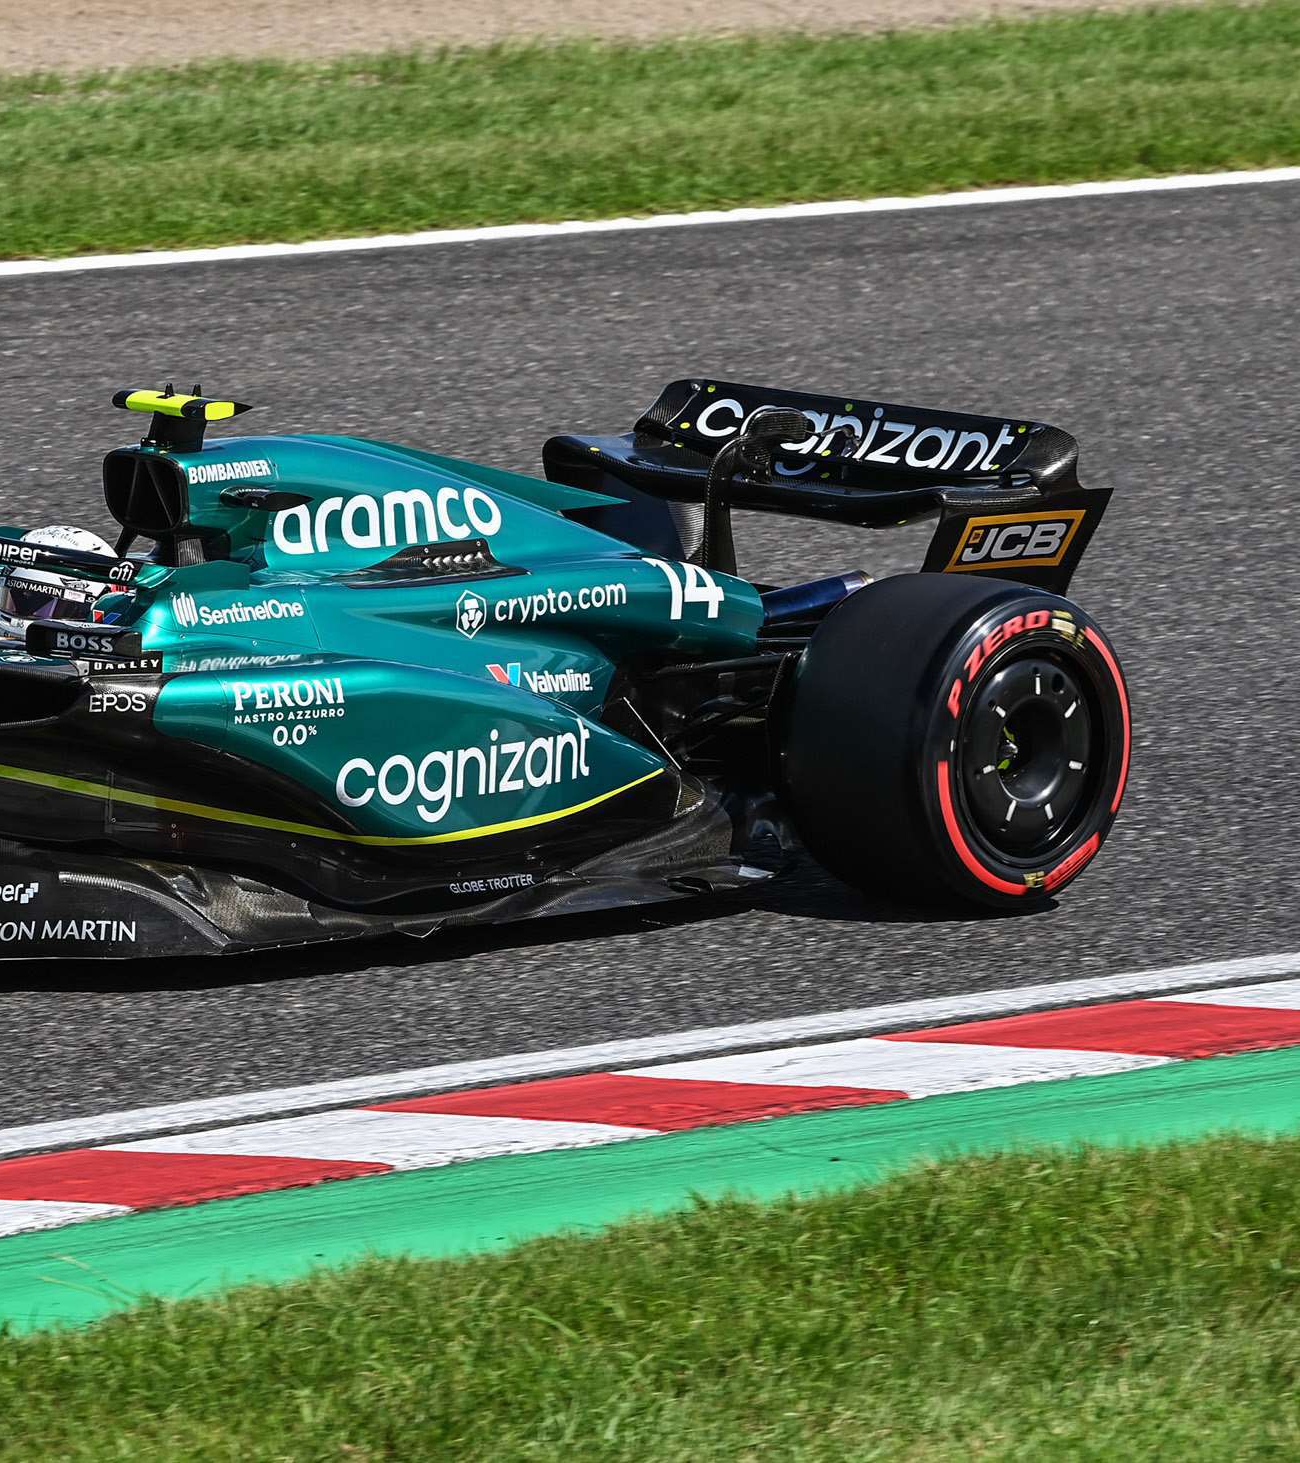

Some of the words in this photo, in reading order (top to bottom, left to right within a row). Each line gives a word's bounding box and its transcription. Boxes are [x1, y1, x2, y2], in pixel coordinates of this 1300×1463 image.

[187, 459, 271, 484] BOMBARDIER
[273, 487, 502, 555] aramco
[961, 523, 1067, 562] JCB
[109, 561, 135, 581] citi
[29, 582, 62, 597] MARTIN
[641, 557, 725, 620] 14
[200, 599, 304, 626] SentinelOne
[494, 583, 627, 624] crypto.com
[56, 631, 114, 653] BOSS
[964, 610, 1051, 682] ZERO
[89, 693, 146, 713] EPOS
[231, 677, 345, 711] PERONI
[234, 713, 284, 725] NASTRO
[287, 707, 345, 720] AZZURRO
[272, 723, 318, 747] 0.0%
[336, 718, 590, 823] cognizant
[41, 920, 137, 942] MARTIN
